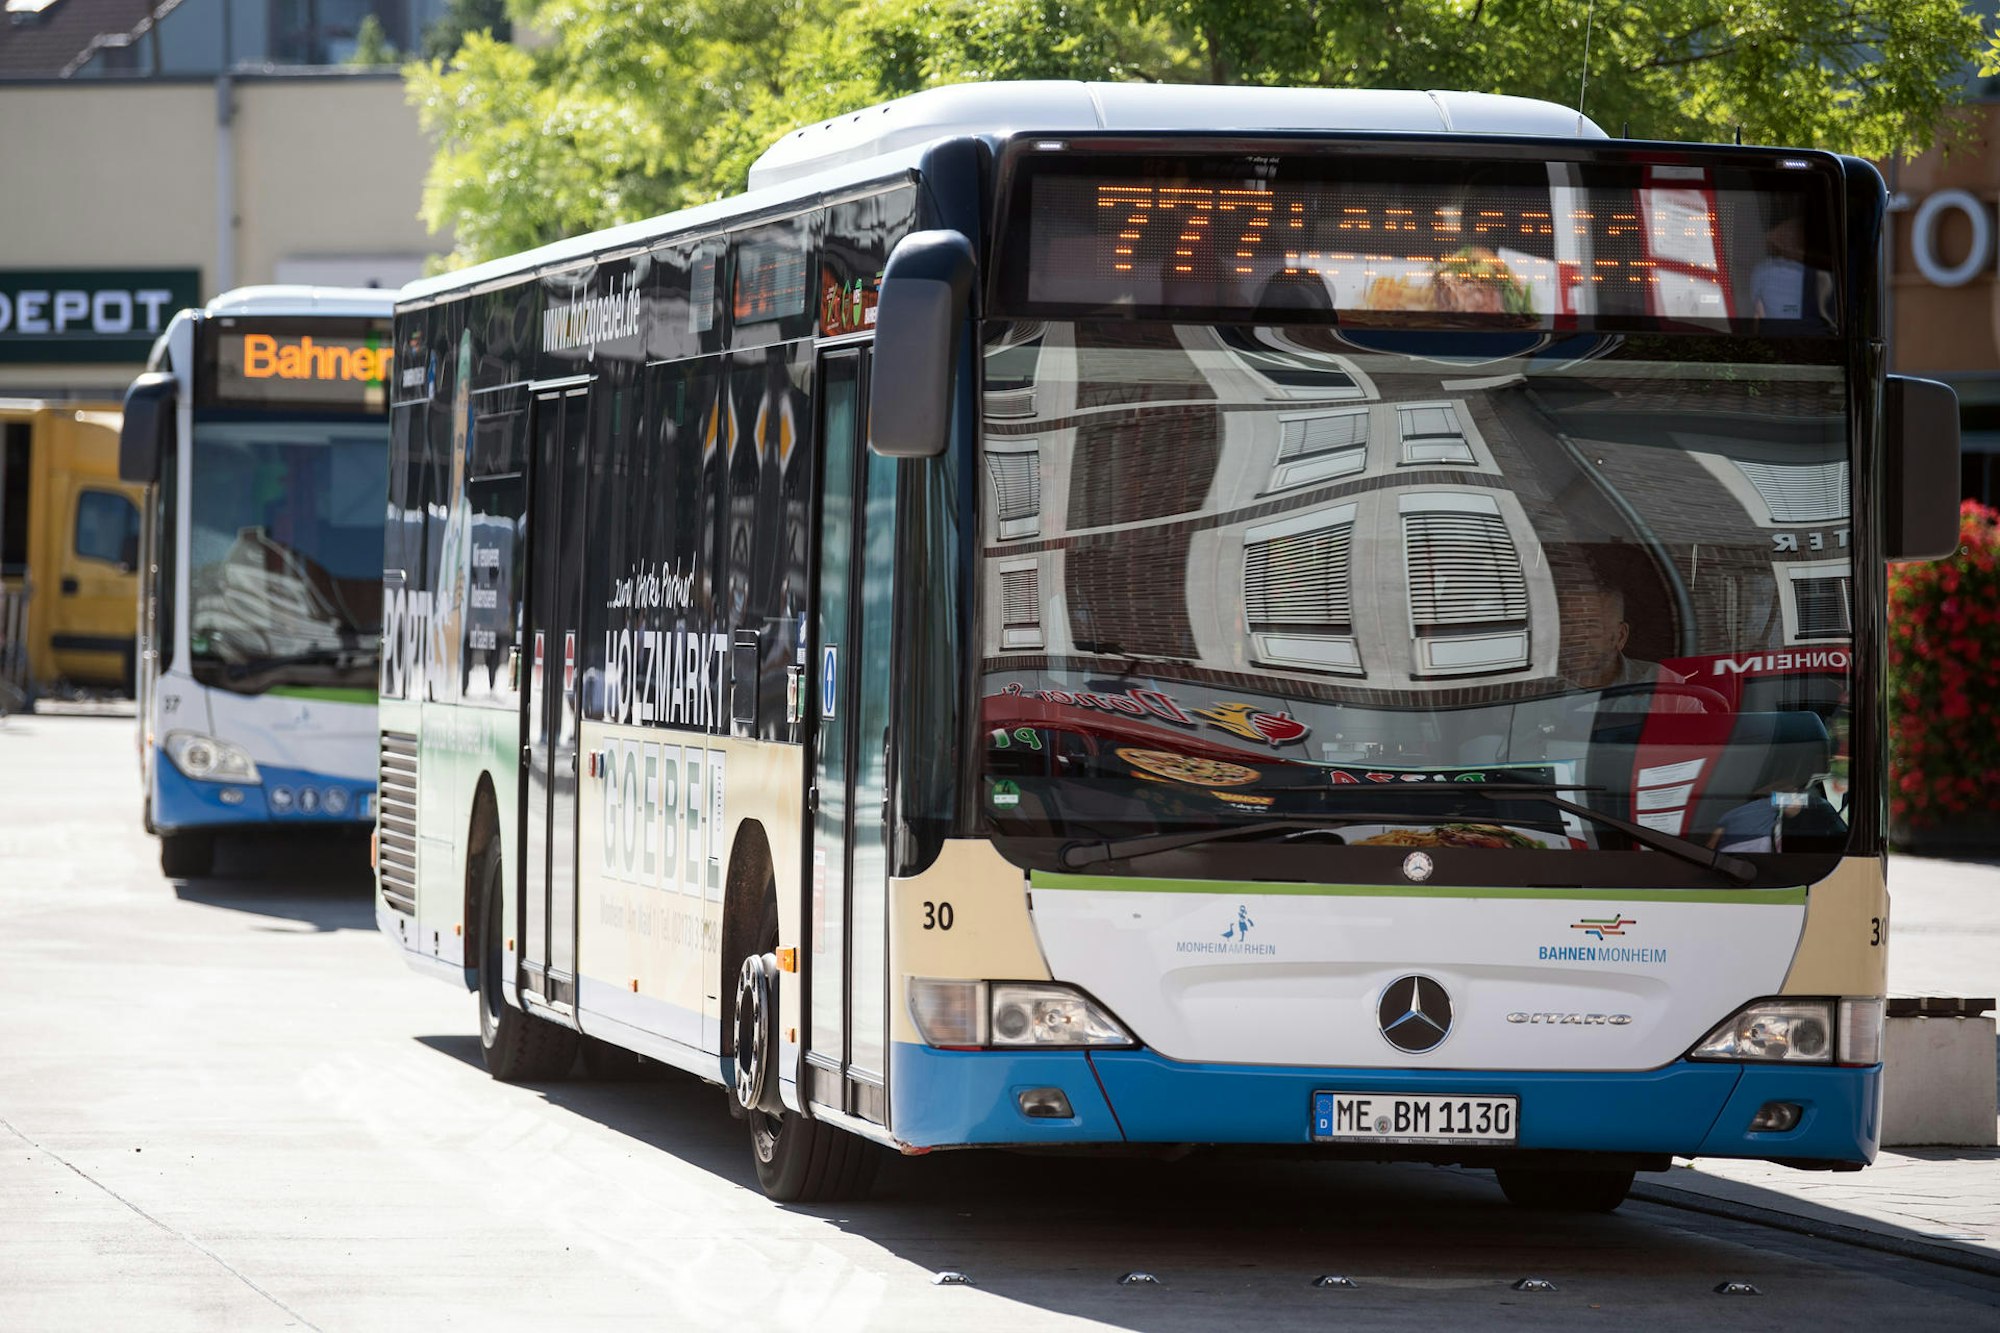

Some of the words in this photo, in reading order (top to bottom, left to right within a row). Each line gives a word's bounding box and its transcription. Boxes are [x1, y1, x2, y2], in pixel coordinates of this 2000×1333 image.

[1098, 186, 1274, 272] 777
[1887, 187, 1990, 288] O
[542, 270, 641, 362] www.holzgoebel.de
[604, 628, 728, 734] HOLZMARKT
[923, 901, 954, 931] 30
[1176, 941, 1227, 954] MONHEIM
[1244, 943, 1276, 956] RHEIN
[1539, 946, 1596, 961] BAHNEN
[1598, 948, 1667, 963] MONHEIM
[1506, 1012, 1633, 1026] CITARO
[1320, 1118, 1328, 1129] D
[1337, 1100, 1372, 1132] ME
[1394, 1101, 1430, 1133] BM
[1439, 1102, 1510, 1135] 1130
